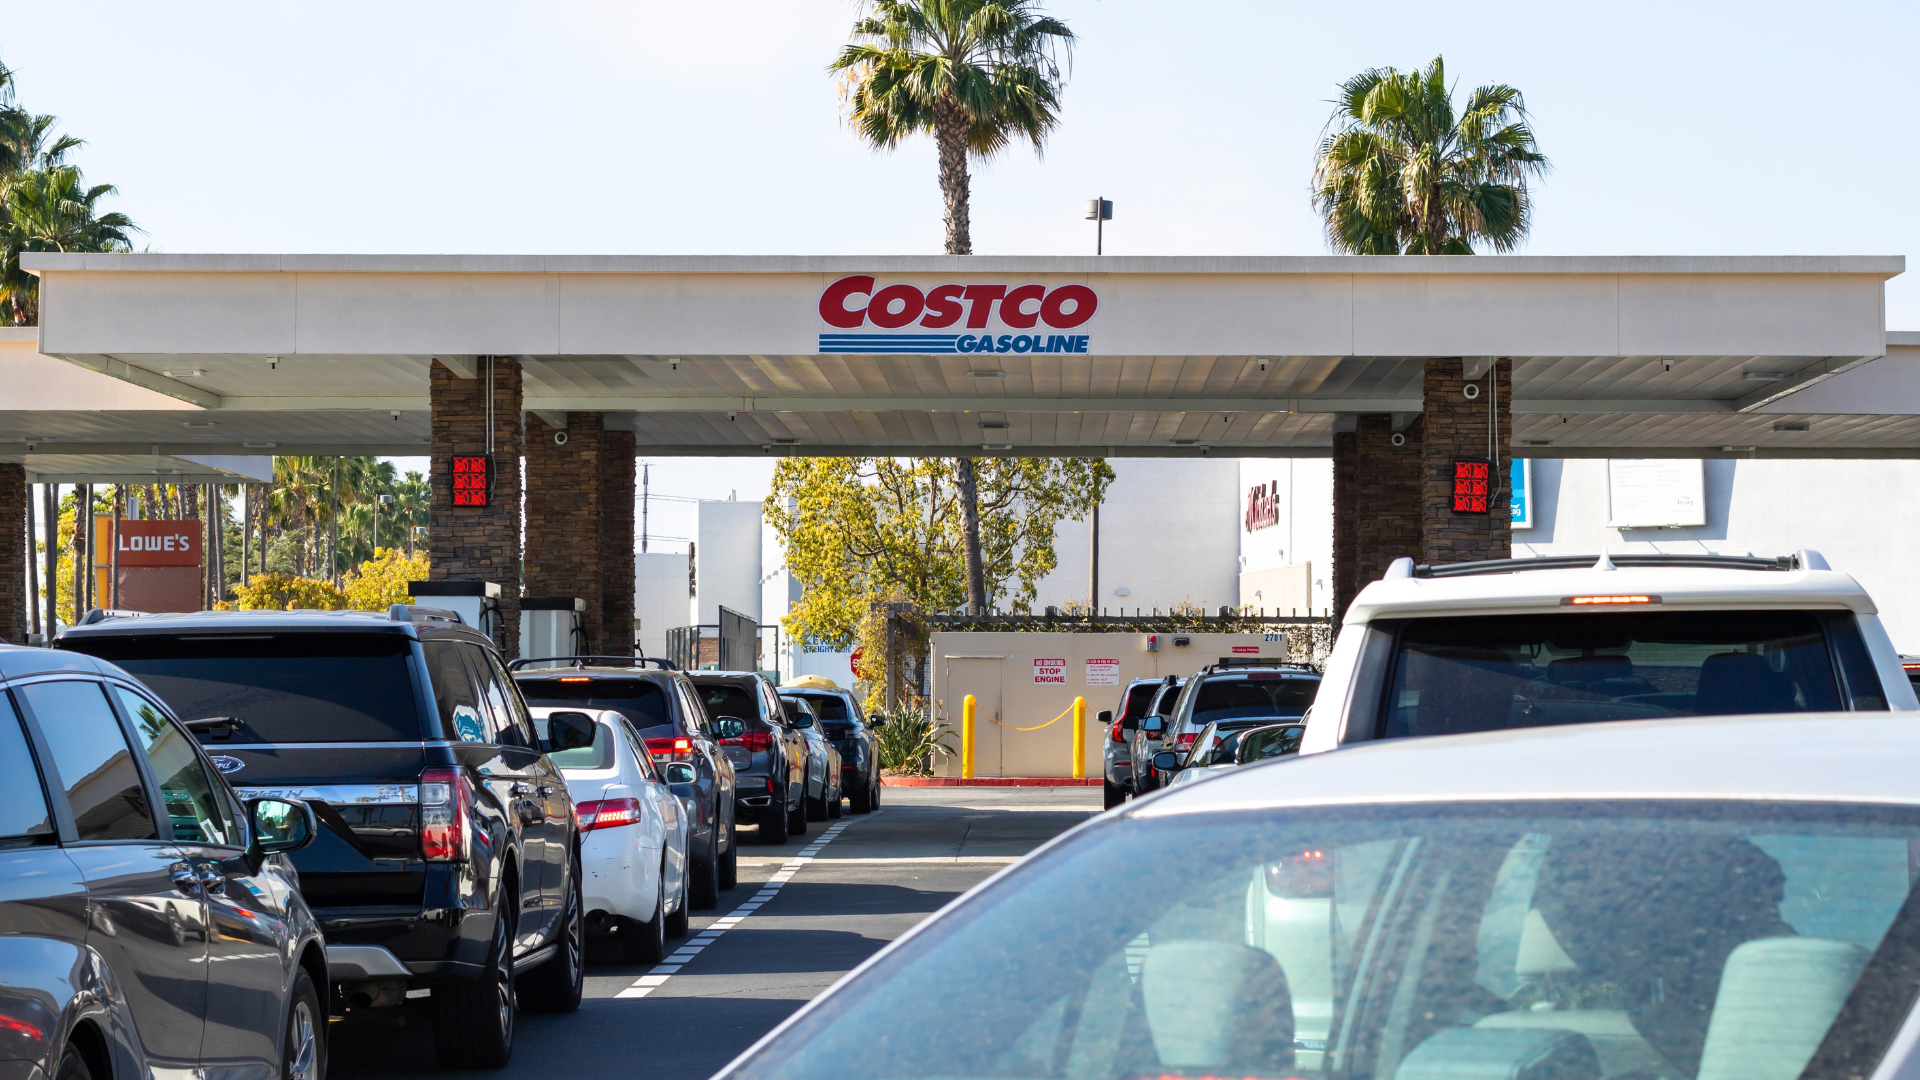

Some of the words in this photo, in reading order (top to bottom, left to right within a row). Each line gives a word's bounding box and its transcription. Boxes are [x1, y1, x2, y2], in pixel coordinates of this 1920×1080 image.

[818, 275, 1098, 329] COSTCO
[955, 334, 1090, 353] GASOLINE
[119, 534, 190, 551] LOWE'S
